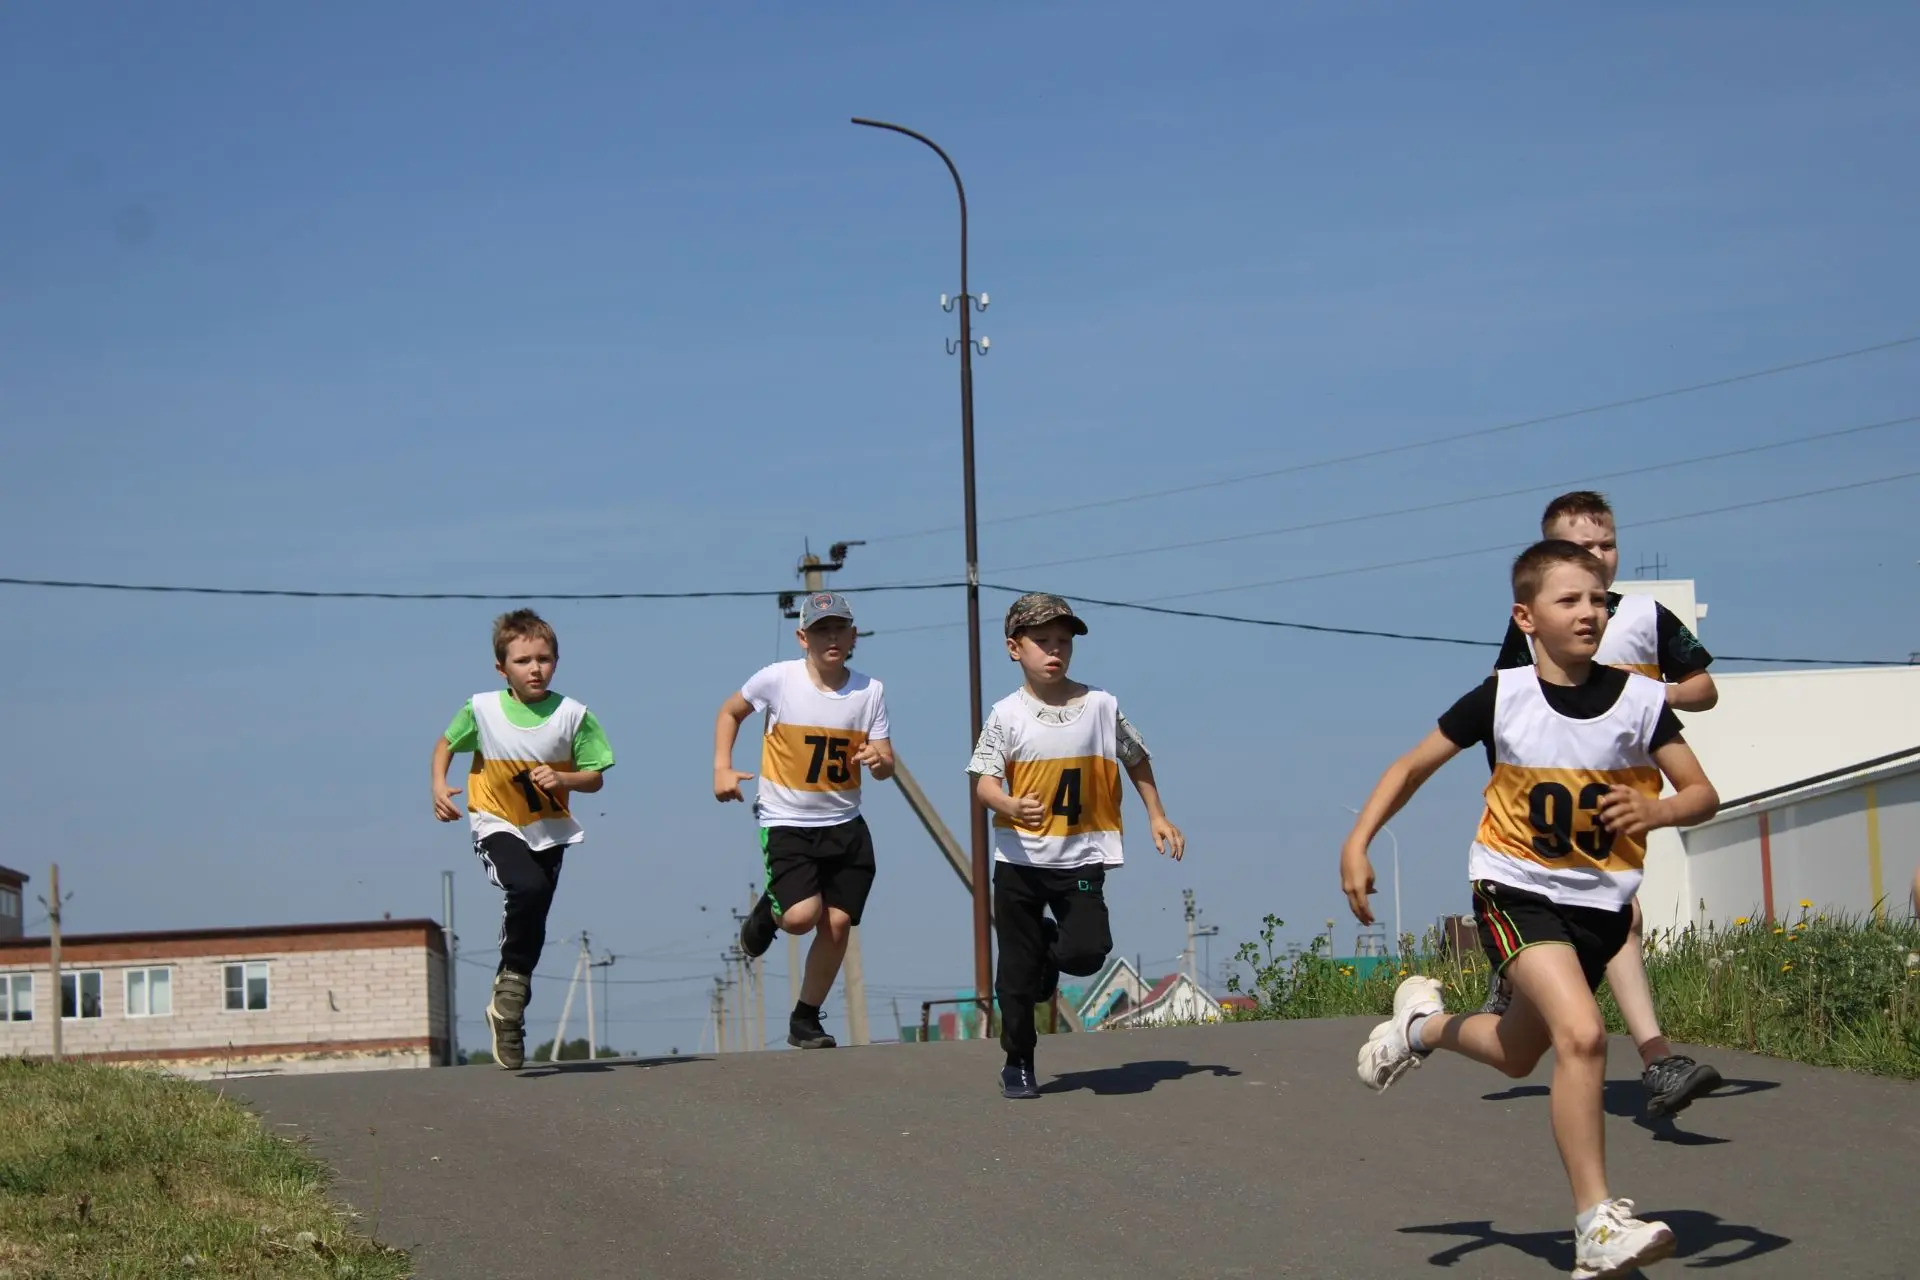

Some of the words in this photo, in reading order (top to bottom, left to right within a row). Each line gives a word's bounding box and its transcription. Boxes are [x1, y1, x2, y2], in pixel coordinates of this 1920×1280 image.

[804, 735, 850, 784] 75
[512, 769, 562, 813] 1
[1052, 767, 1082, 826] 4
[1528, 781, 1616, 860] 93
